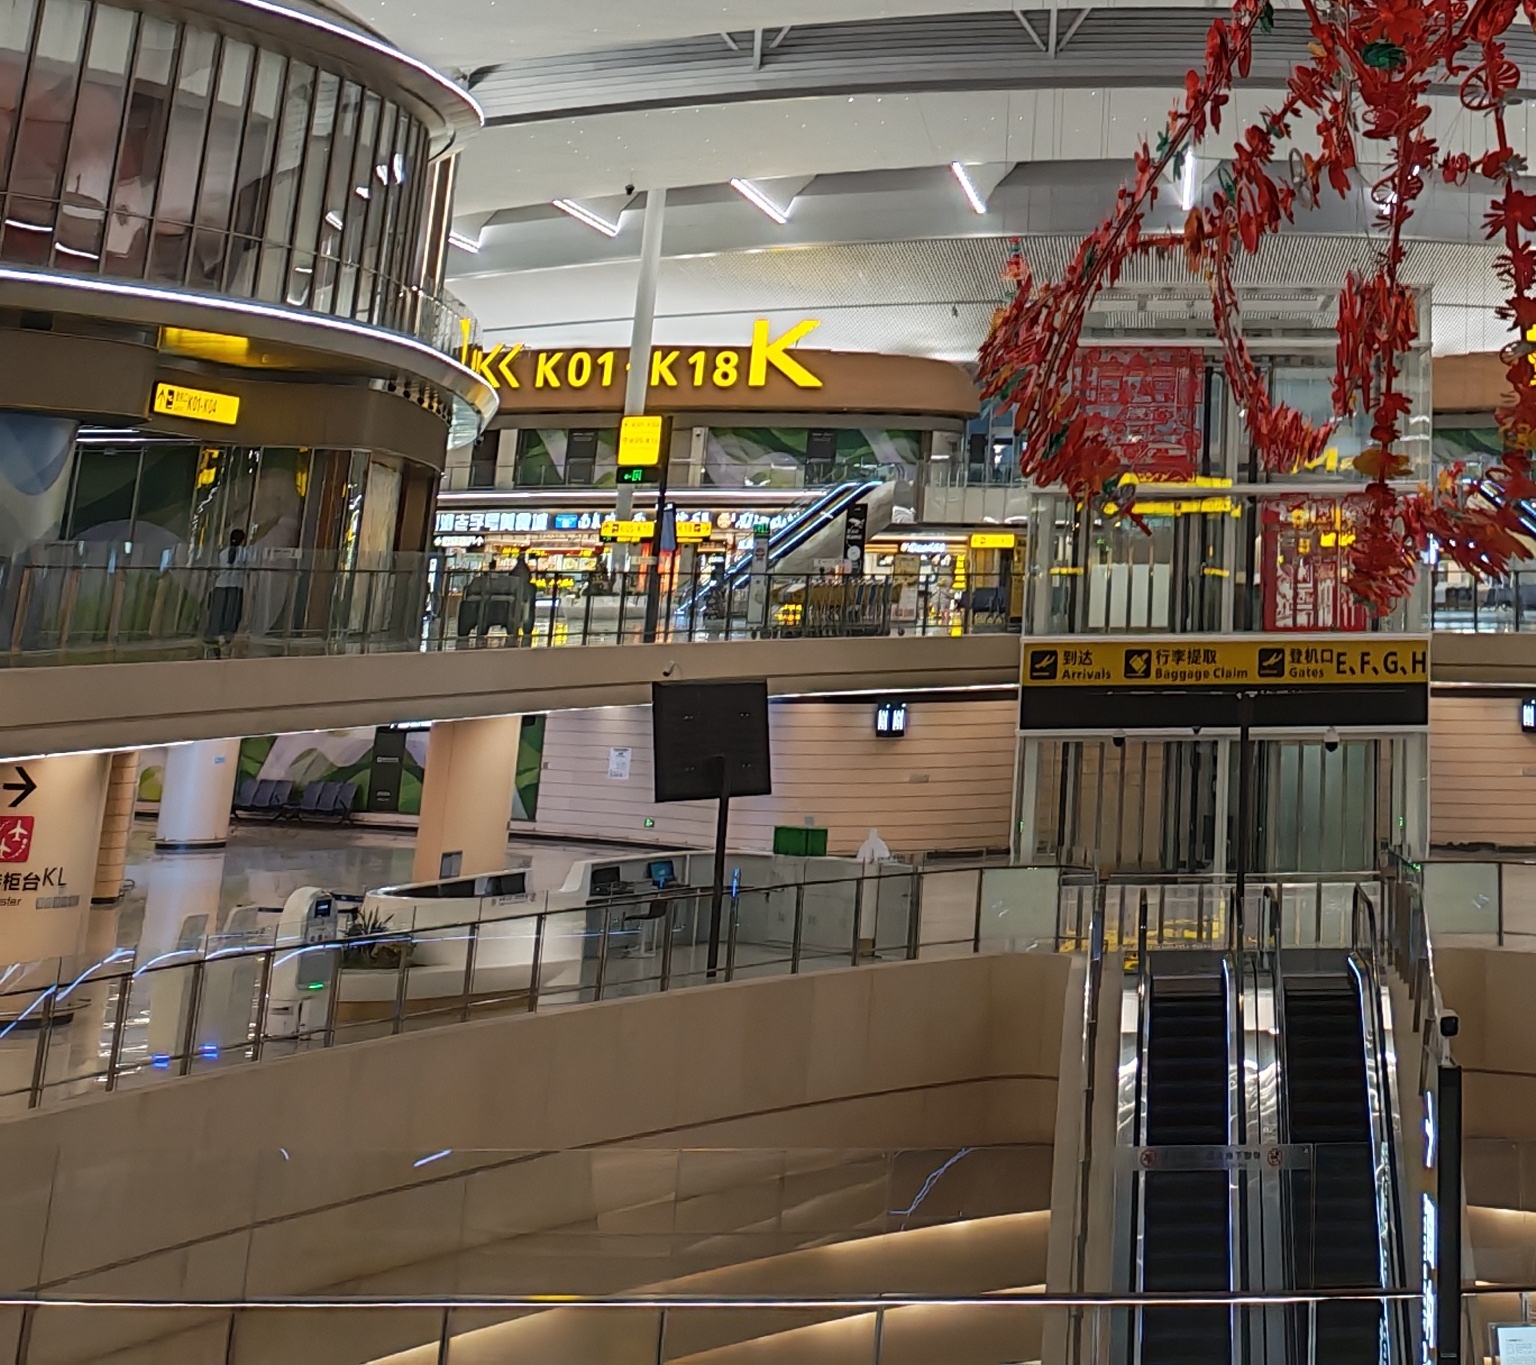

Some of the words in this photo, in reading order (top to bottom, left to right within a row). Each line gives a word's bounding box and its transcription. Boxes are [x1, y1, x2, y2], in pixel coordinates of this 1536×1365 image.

[535, 350, 615, 388] K01
[650, 350, 739, 388] K18
[748, 318, 823, 387] K
[1062, 649, 1093, 666] 到达
[1155, 648, 1217, 666] 行李提取
[1289, 647, 1334, 664] 登机口
[1062, 668, 1111, 680] Arrivals
[1155, 667, 1210, 681] Baggage
[1213, 666, 1248, 679] Claim
[1289, 667, 1325, 679] Gates
[0, 871, 41, 891] 柜台
[42, 866, 67, 887] KL
